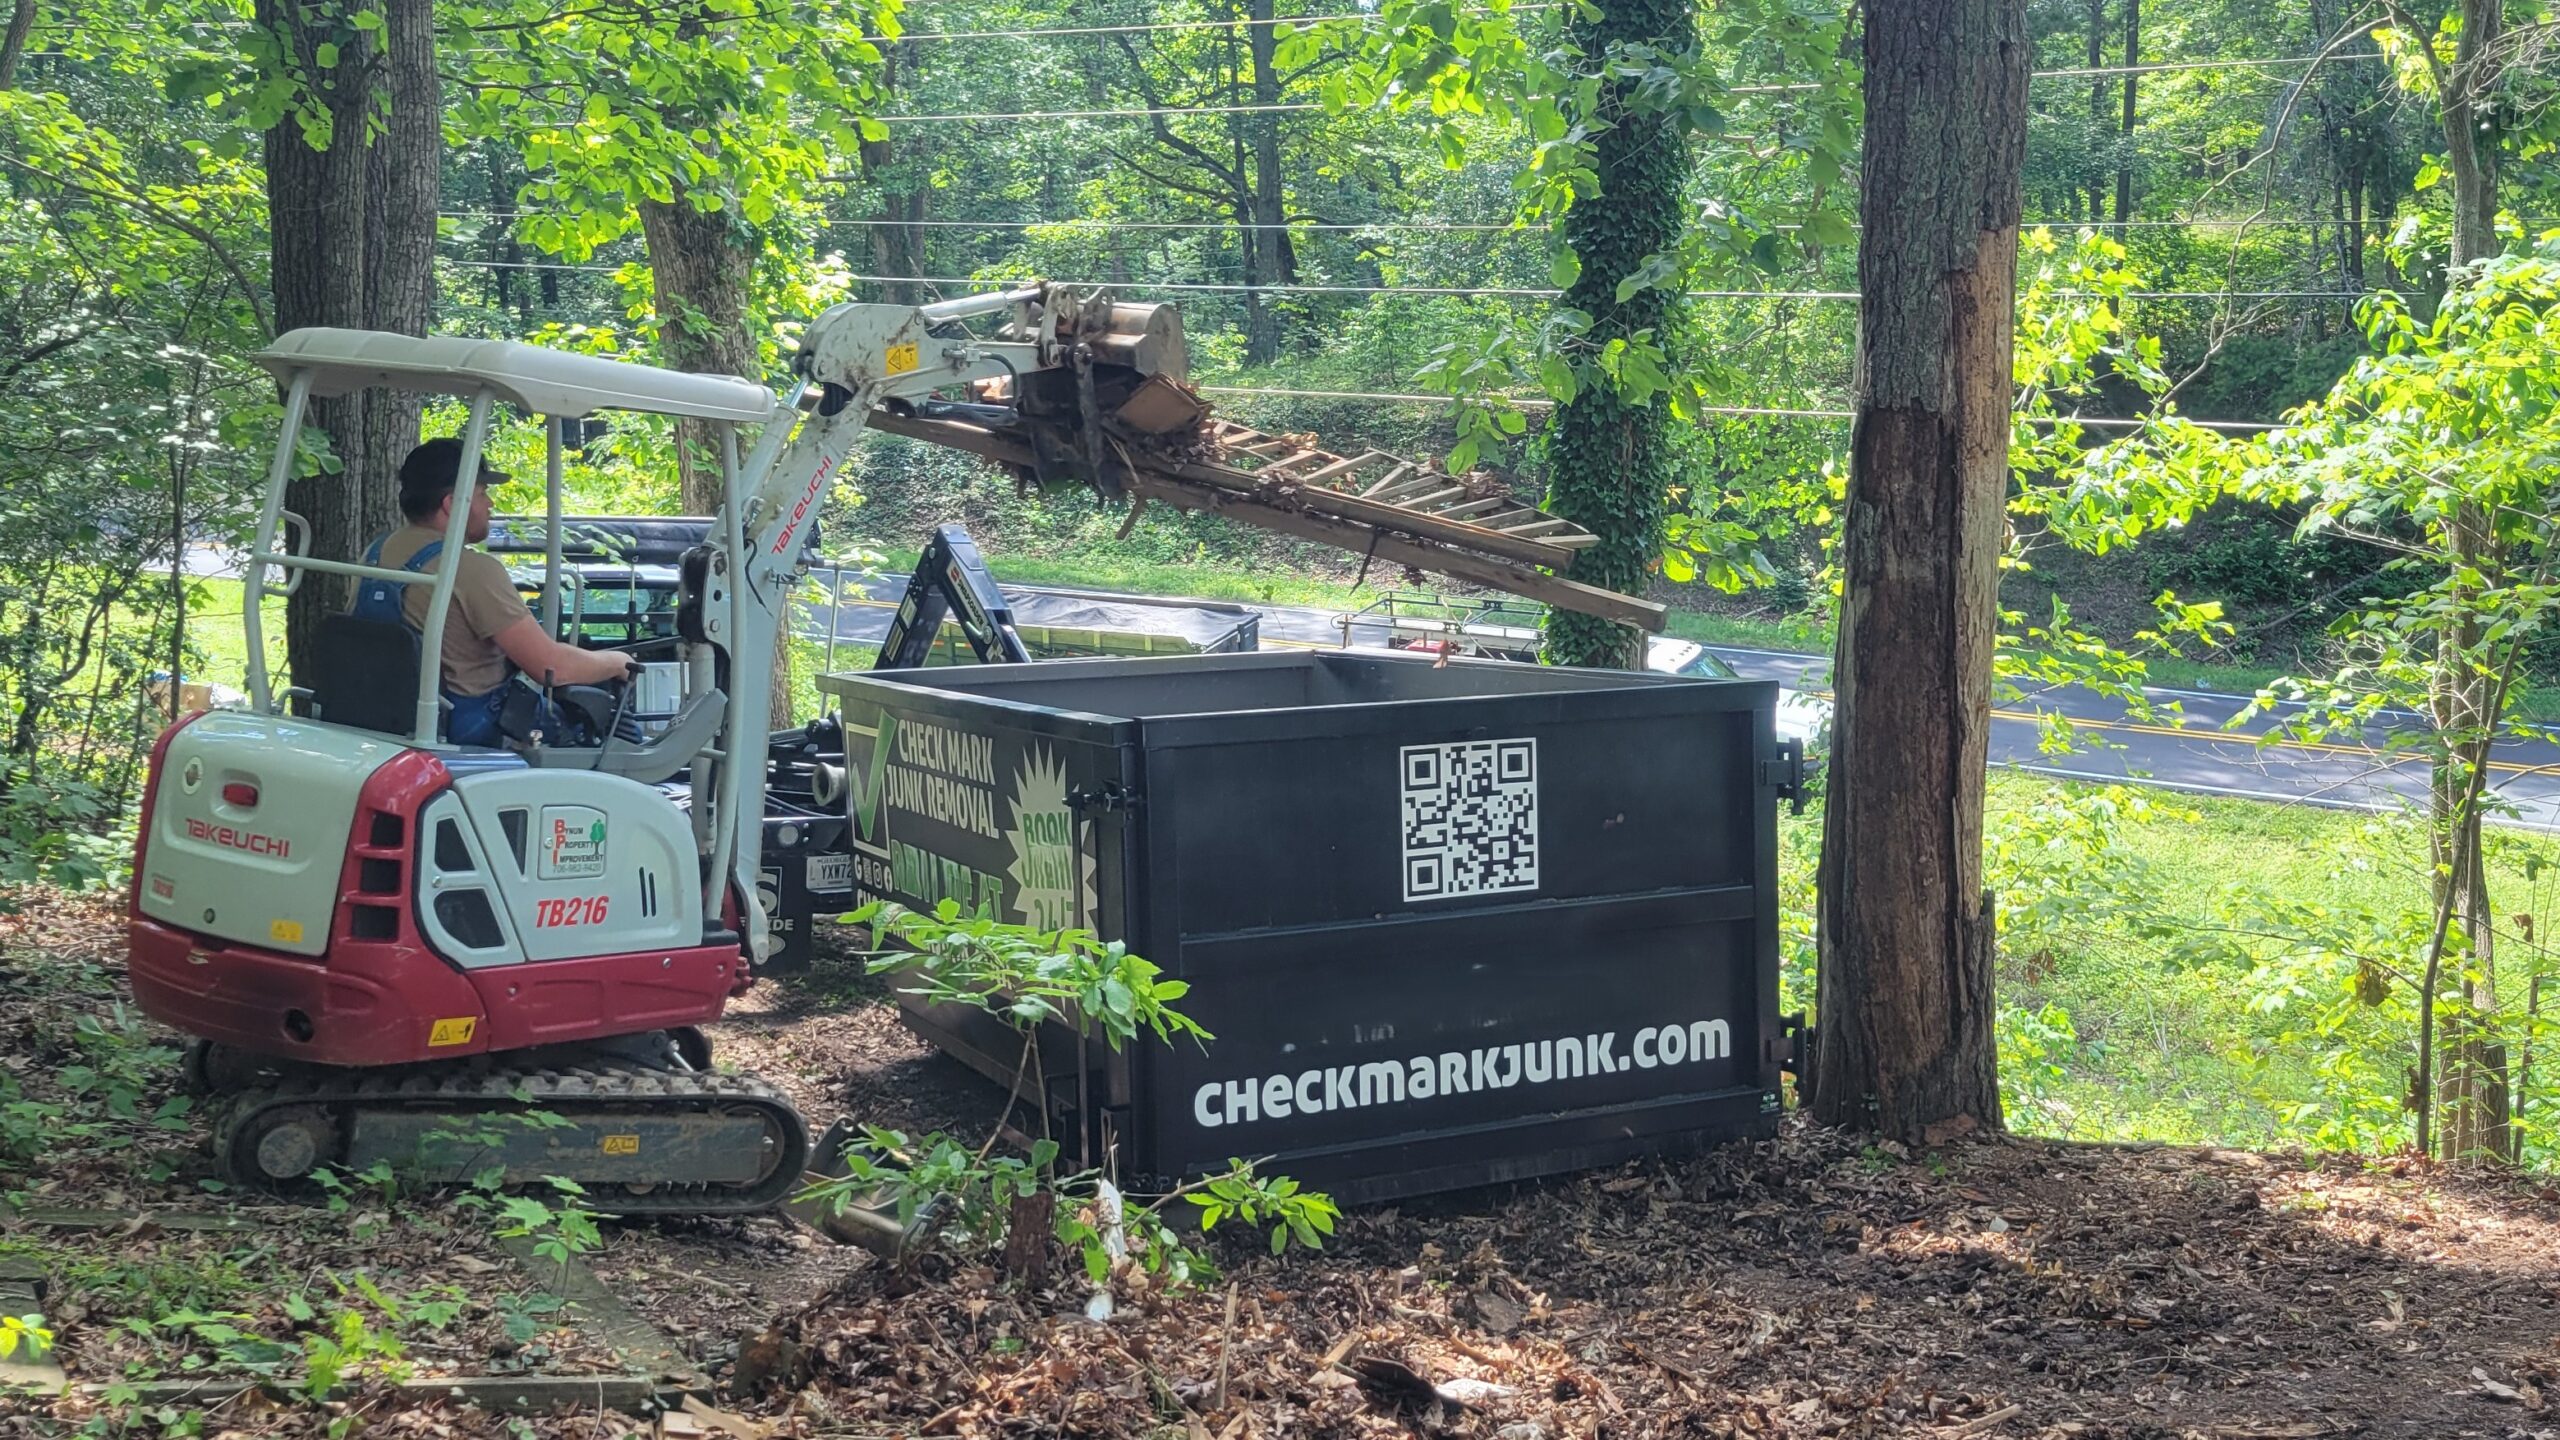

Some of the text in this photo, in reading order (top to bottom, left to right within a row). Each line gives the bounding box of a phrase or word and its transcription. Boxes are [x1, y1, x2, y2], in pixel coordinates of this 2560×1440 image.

[897, 719, 996, 786] CHECK MARK
[886, 764, 1000, 840] JUNK REMOVAL
[554, 818, 584, 835] BYNUM
[556, 835, 595, 850] PROPERTY
[1022, 812, 1072, 846] BOOK
[553, 850, 604, 865] IMPROVEMENT
[536, 895, 610, 928] TB216
